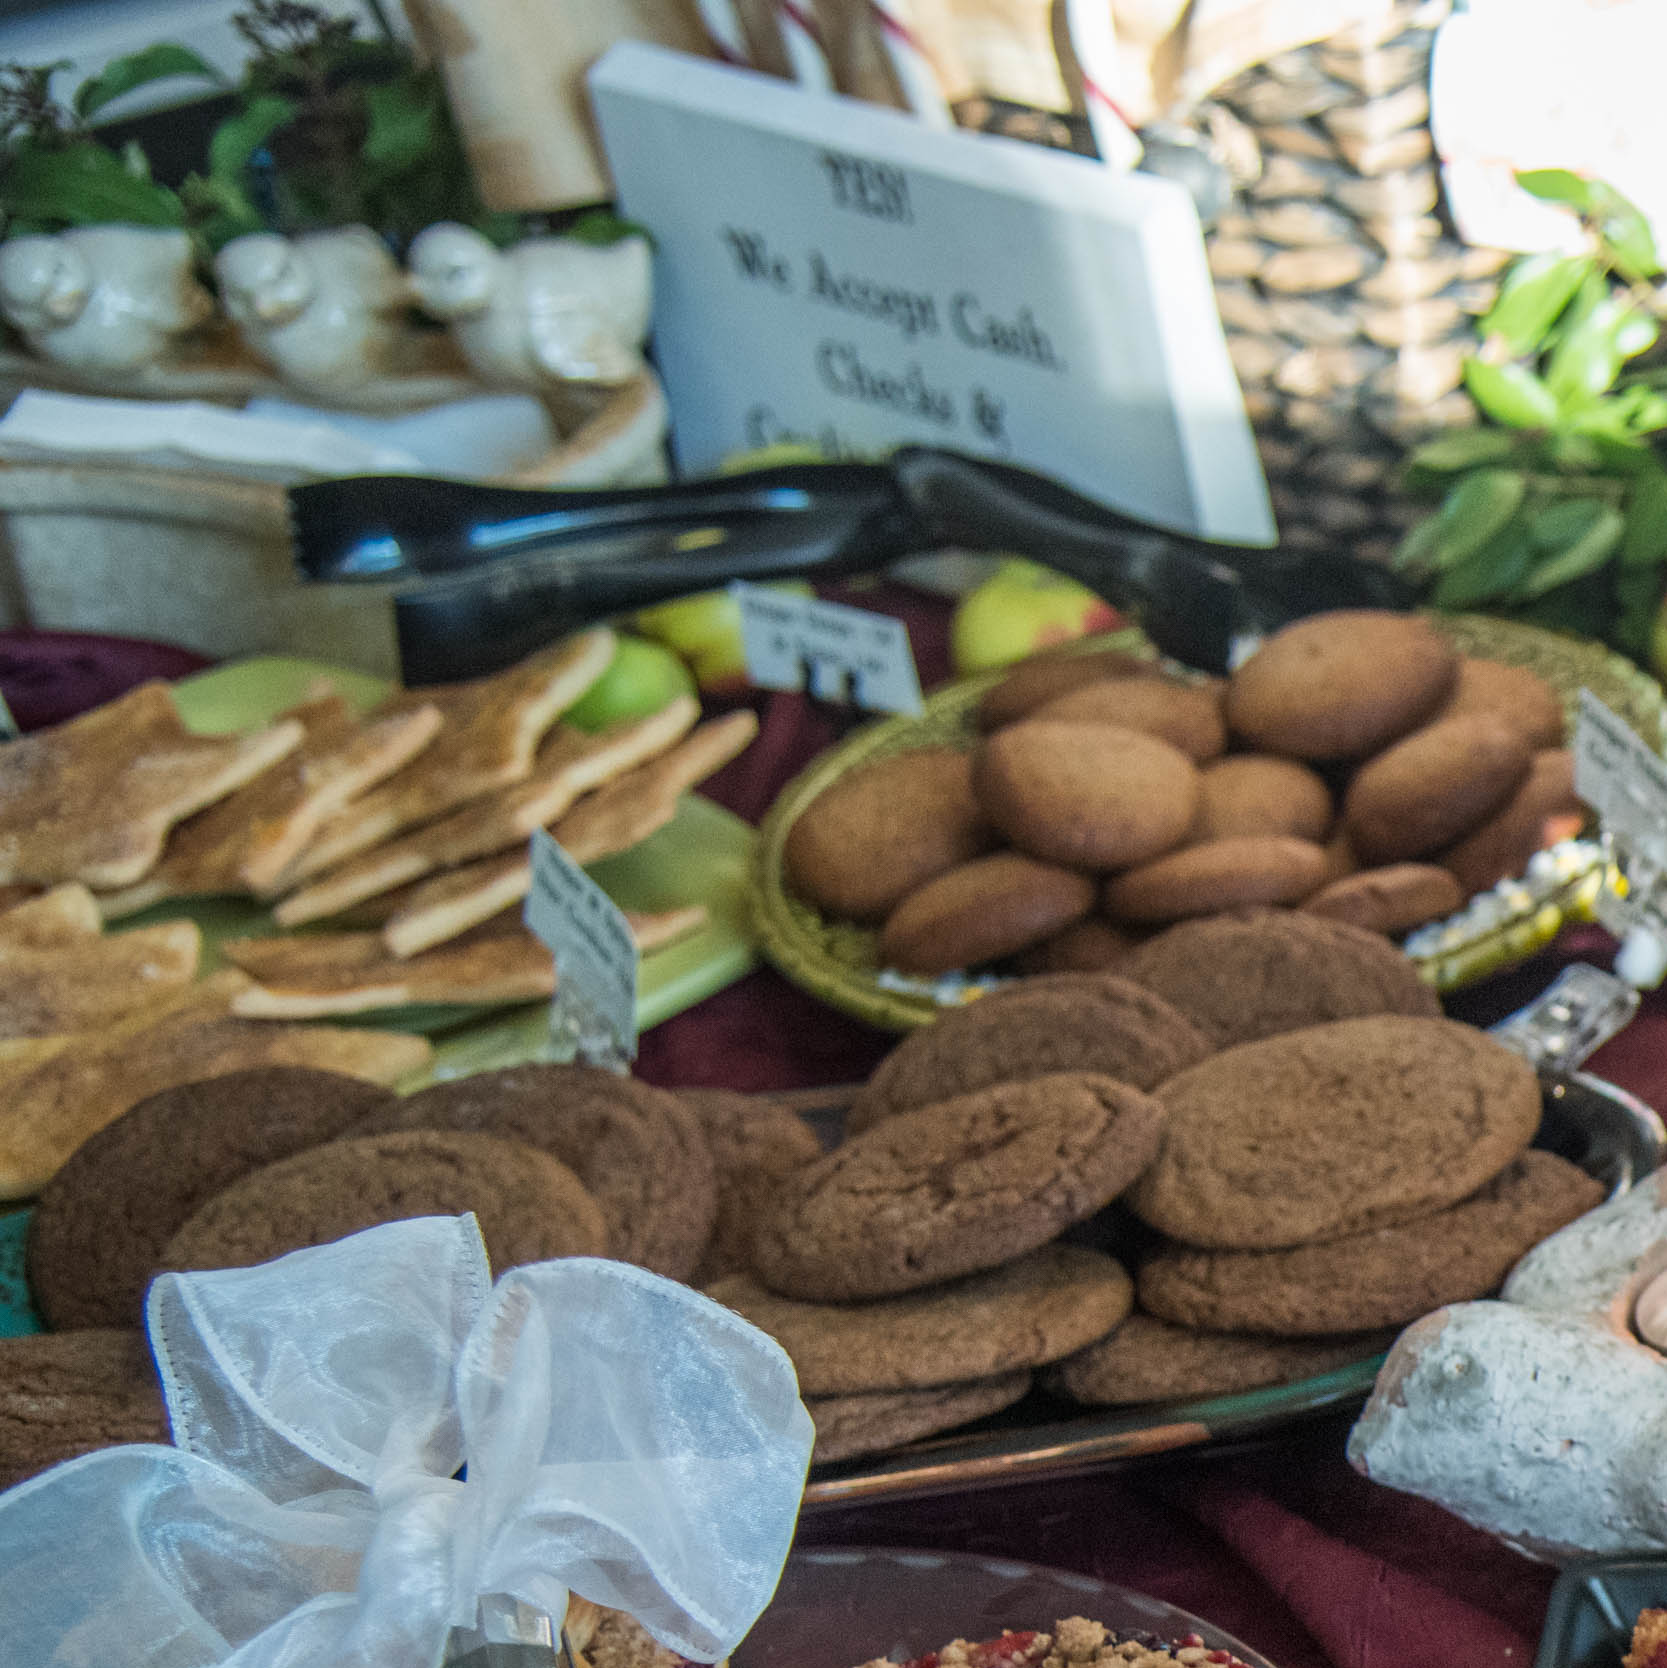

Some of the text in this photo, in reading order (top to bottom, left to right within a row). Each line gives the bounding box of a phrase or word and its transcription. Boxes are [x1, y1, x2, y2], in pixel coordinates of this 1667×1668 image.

[724, 226, 789, 290] We
[807, 250, 938, 338] Accept
[817, 341, 952, 426] Checks
